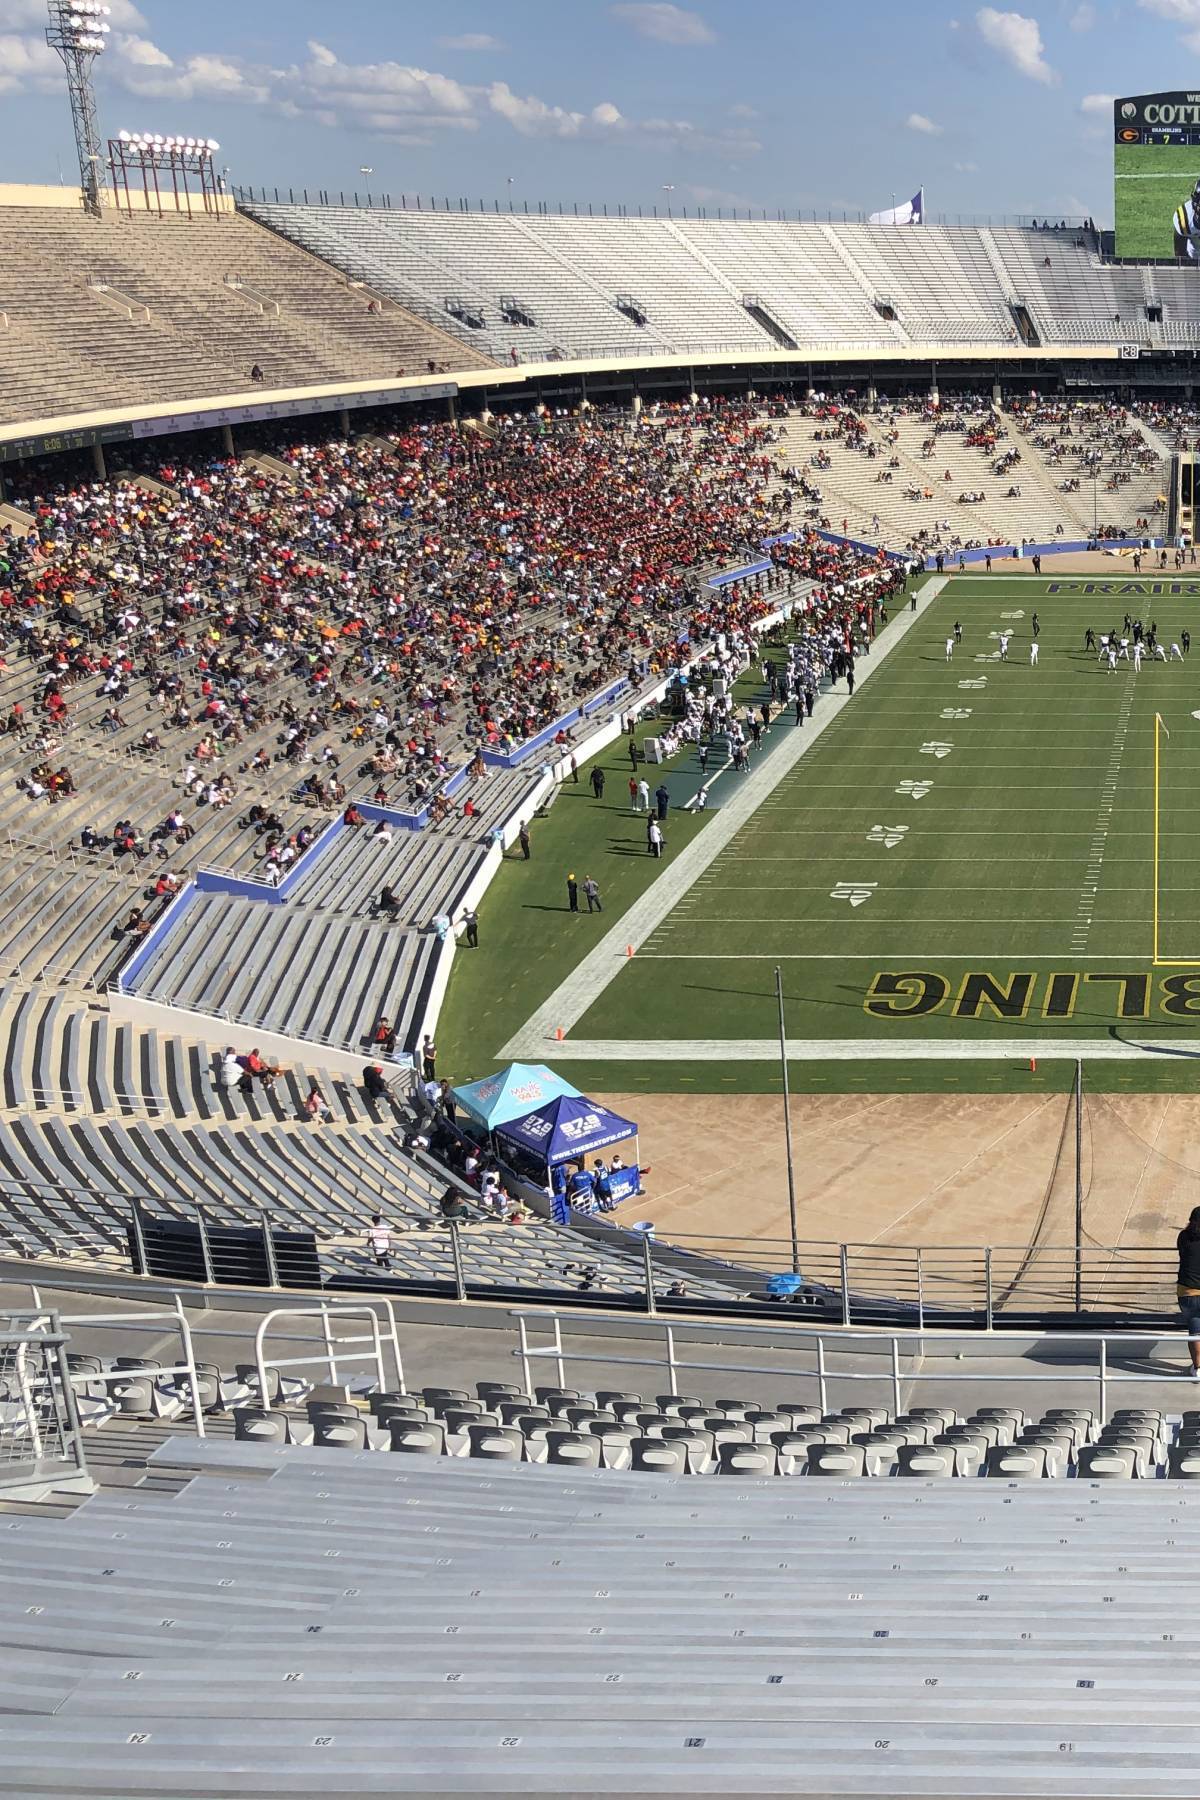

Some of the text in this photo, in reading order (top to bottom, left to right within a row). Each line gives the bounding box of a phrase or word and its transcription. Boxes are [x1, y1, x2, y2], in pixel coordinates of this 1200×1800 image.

[1163, 135, 1170, 144] 7
[1123, 346, 1136, 357] 28
[939, 708, 972, 719] 50
[894, 780, 934, 793] 30
[865, 825, 910, 841] 20
[830, 882, 878, 899] 10
[560, 1114, 600, 1132] 97.9
[125, 1671, 140, 1680] 25
[286, 1673, 300, 1681] 24
[446, 1671, 462, 1681] 23
[605, 1674, 620, 1682] 22
[770, 1675, 783, 1684] 21
[924, 1678, 939, 1686] 20
[1076, 1680, 1091, 1688] 19
[130, 1734, 147, 1743] 24
[314, 1737, 332, 1746] 23
[502, 1737, 519, 1746] 22
[688, 1738, 702, 1747] 21
[874, 1739, 891, 1749] 20
[1059, 1742, 1073, 1752] 19
